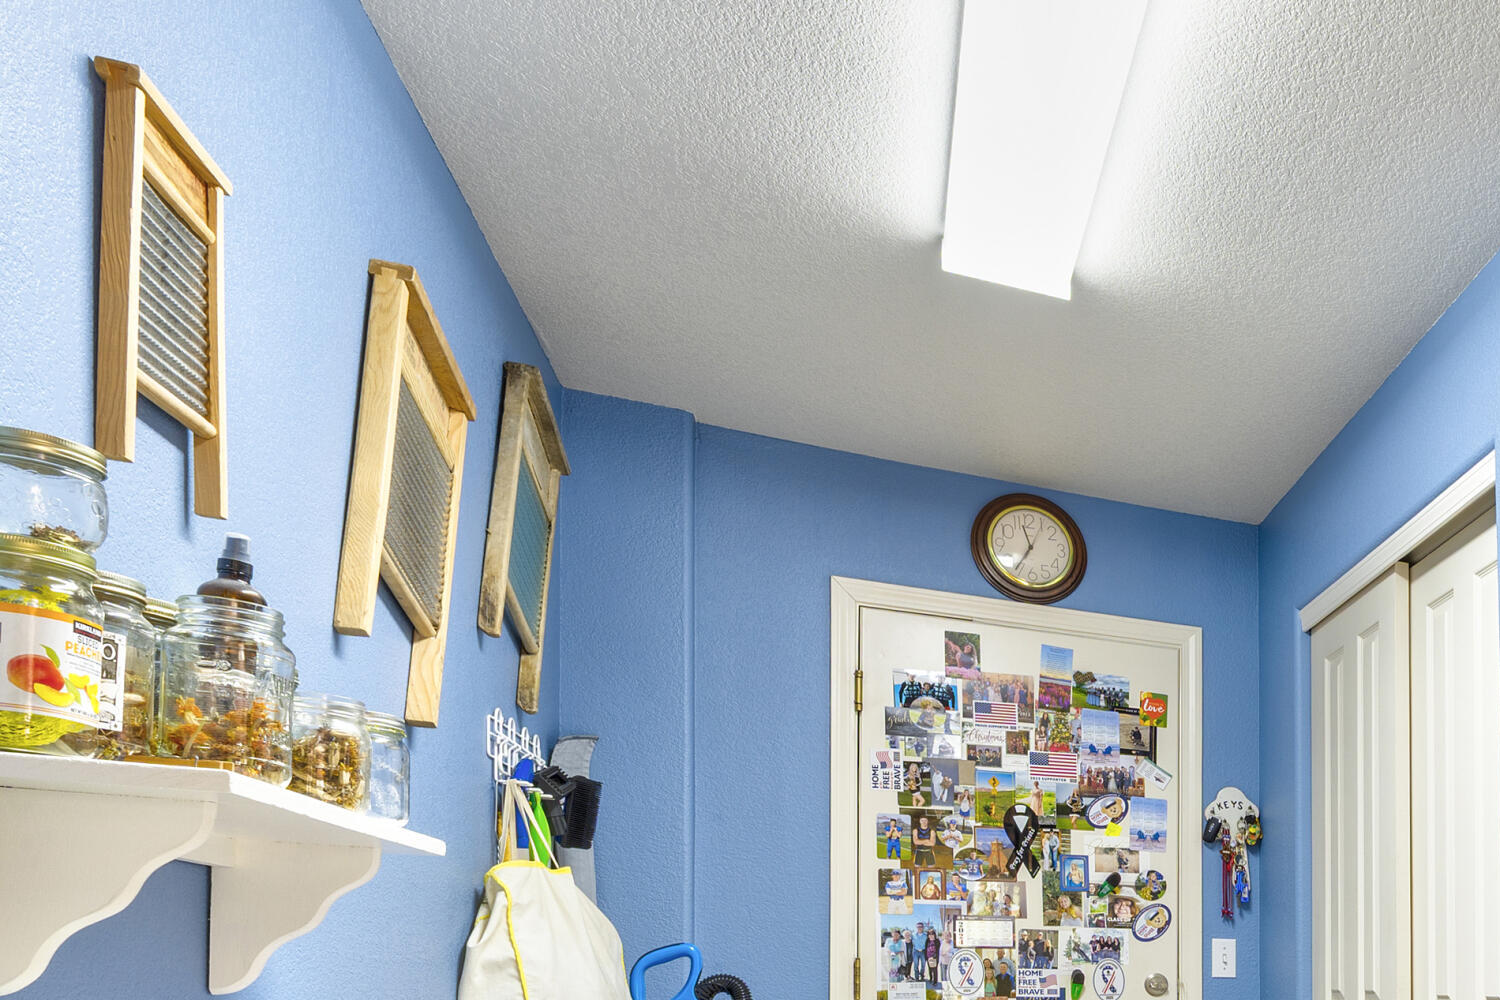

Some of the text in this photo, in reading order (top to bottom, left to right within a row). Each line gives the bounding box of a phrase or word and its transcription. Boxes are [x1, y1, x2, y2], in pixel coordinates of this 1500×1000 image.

[1023, 513, 1035, 529] 12
[1047, 526, 1057, 542] 2
[995, 537, 1005, 553] 9
[1057, 544, 1066, 559] 3
[1040, 565, 1051, 580] 5
[1050, 558, 1060, 572] 4
[1027, 567, 1038, 582] 6
[1143, 698, 1165, 713] love
[882, 770, 890, 789] FREE
[1216, 800, 1243, 811] KEYS
[1018, 969, 1043, 977] HOME
